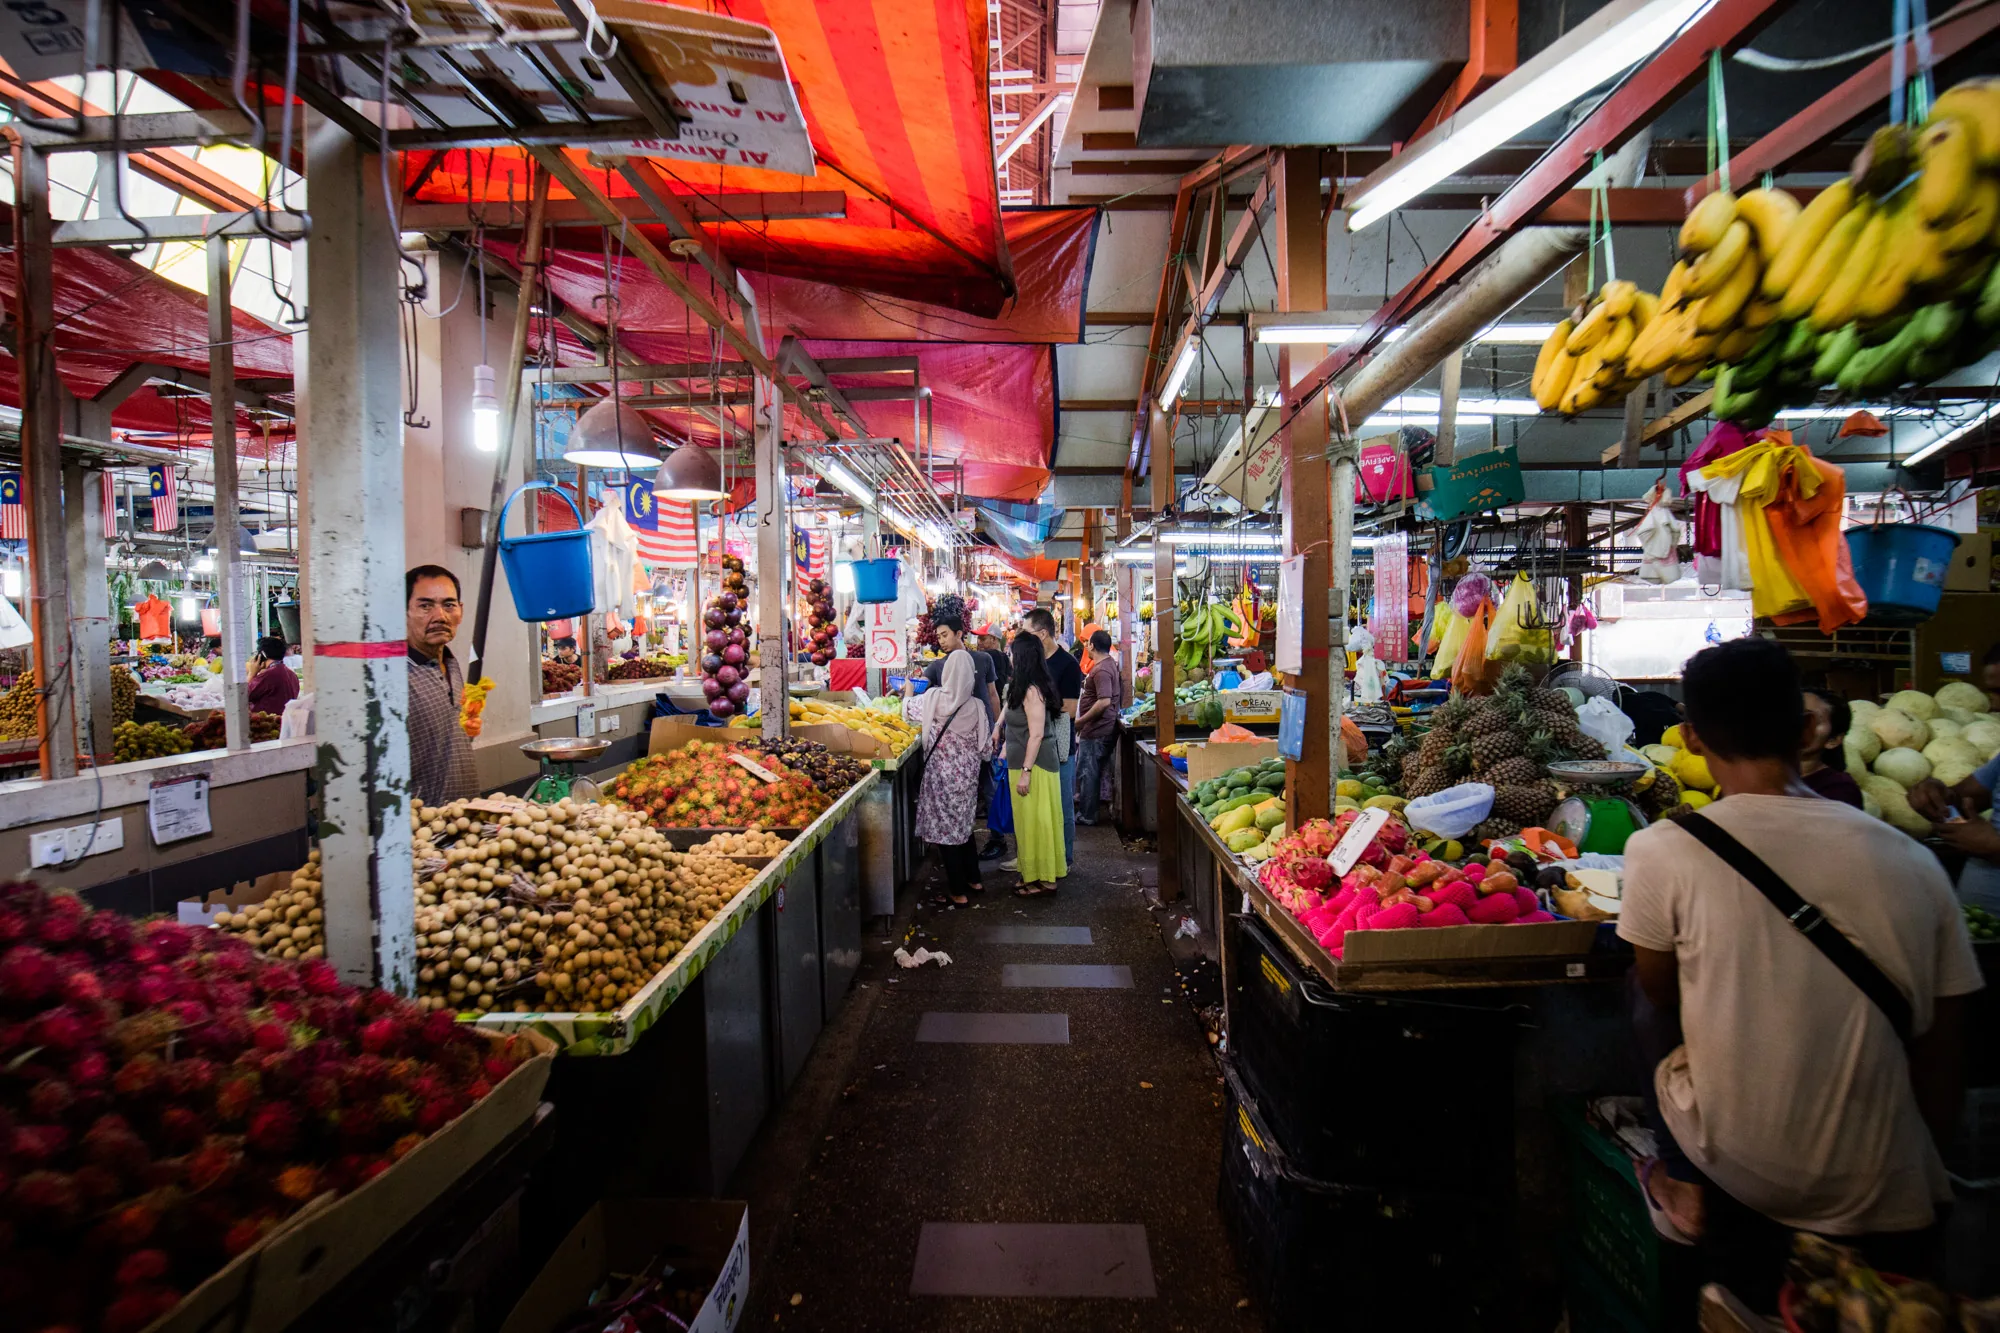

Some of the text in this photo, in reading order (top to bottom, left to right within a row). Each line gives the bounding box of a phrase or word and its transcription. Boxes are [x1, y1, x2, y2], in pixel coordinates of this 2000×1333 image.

[755, 110, 787, 124] Al
[630, 139, 769, 165] Al Anwar
[872, 630, 898, 664] 5
[1235, 698, 1272, 709] KOREAN
